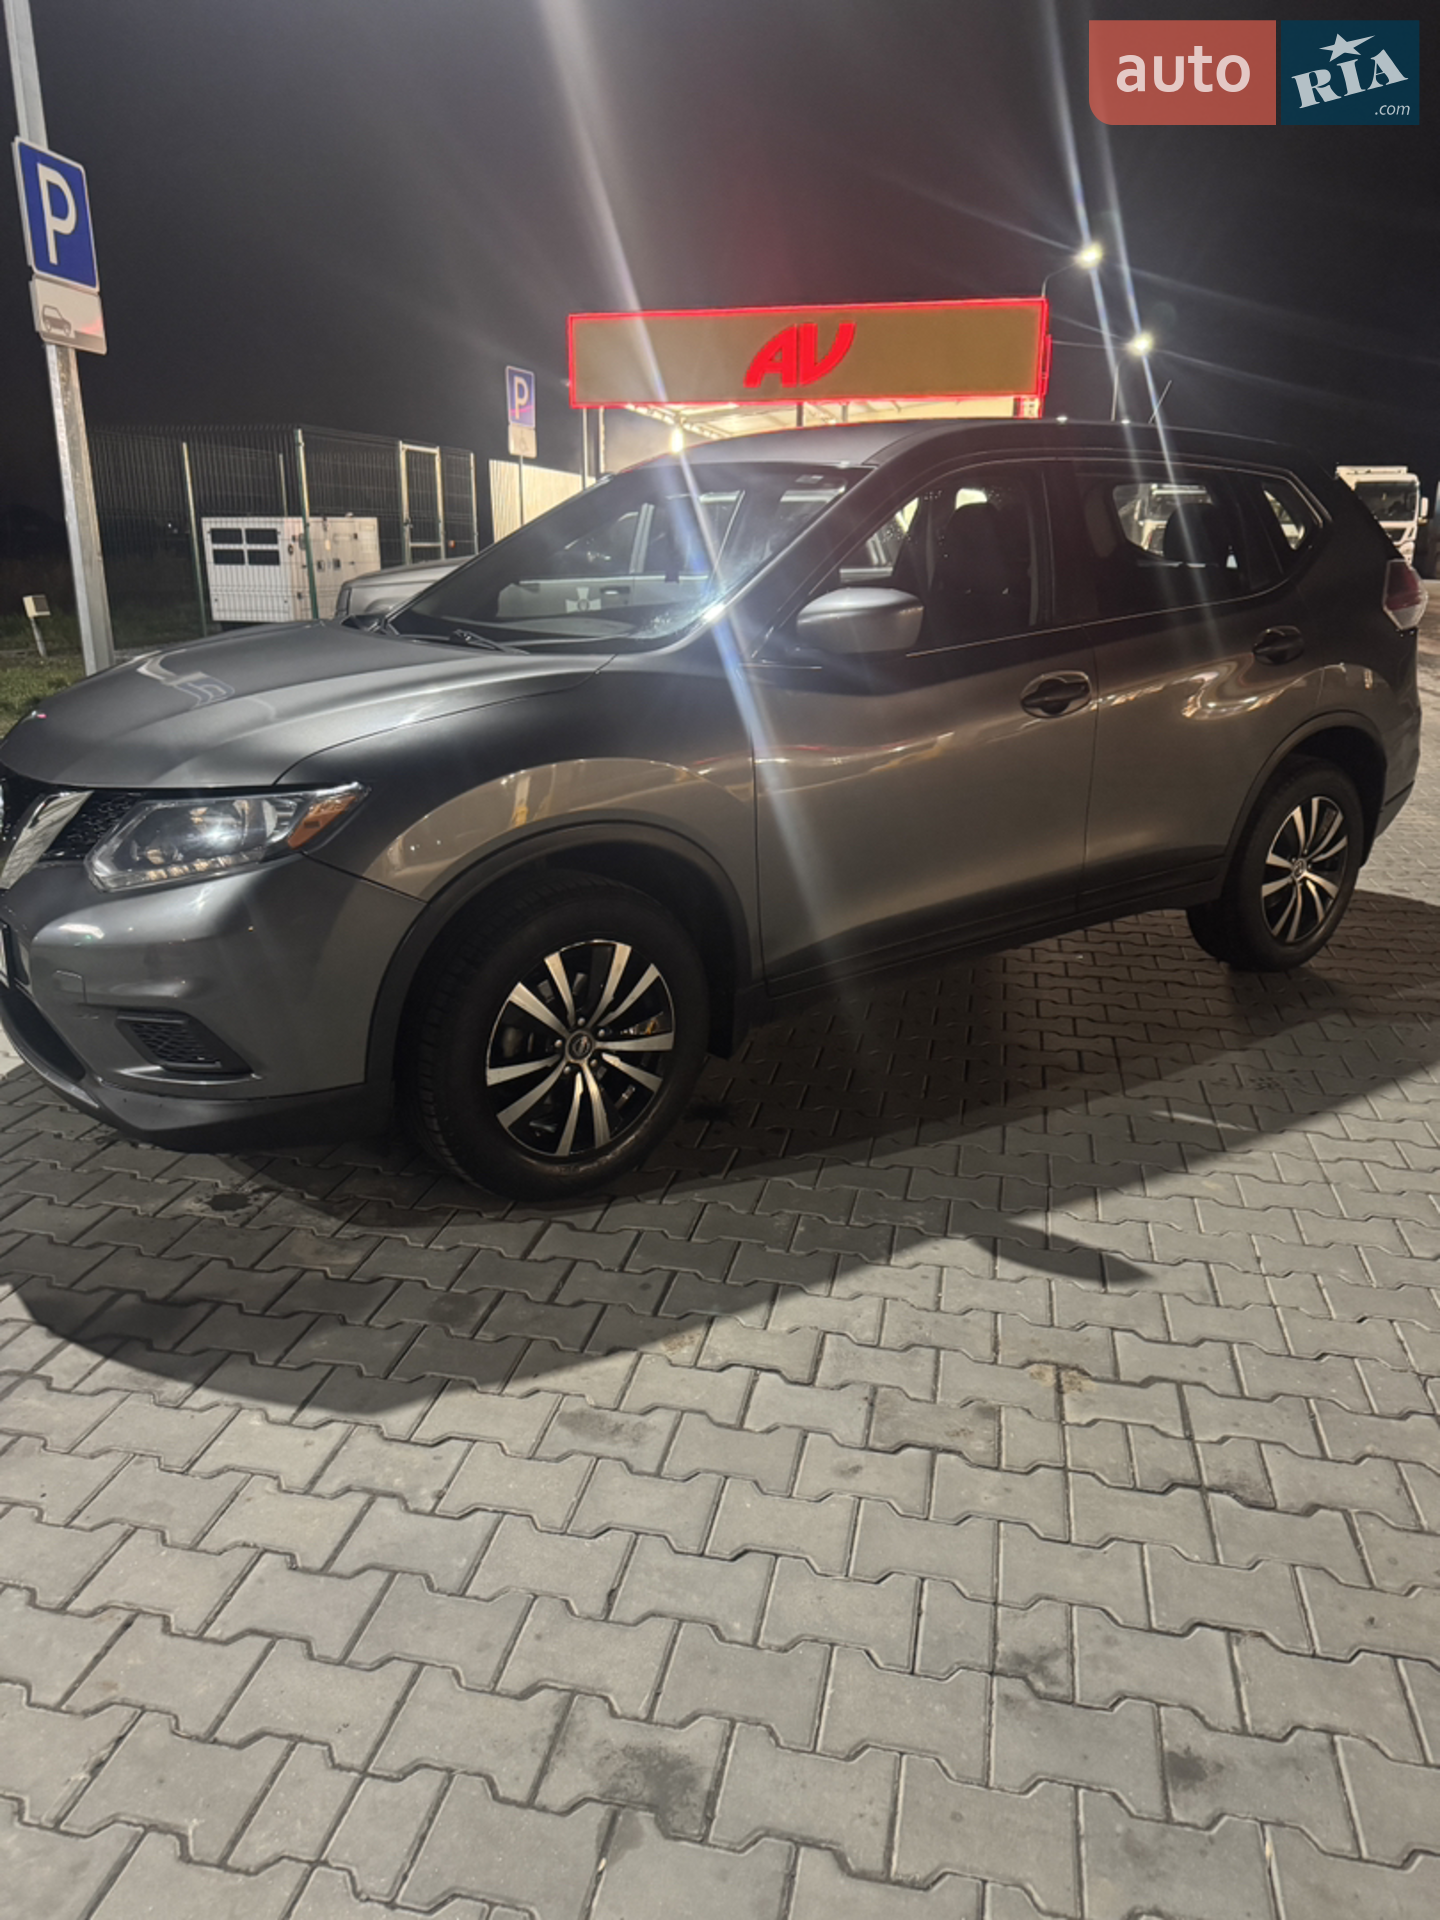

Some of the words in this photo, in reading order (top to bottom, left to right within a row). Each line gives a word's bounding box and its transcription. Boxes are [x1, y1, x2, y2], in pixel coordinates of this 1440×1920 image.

[37, 162, 77, 265] P
[743, 322, 855, 388] AV
[514, 375, 530, 420] P
